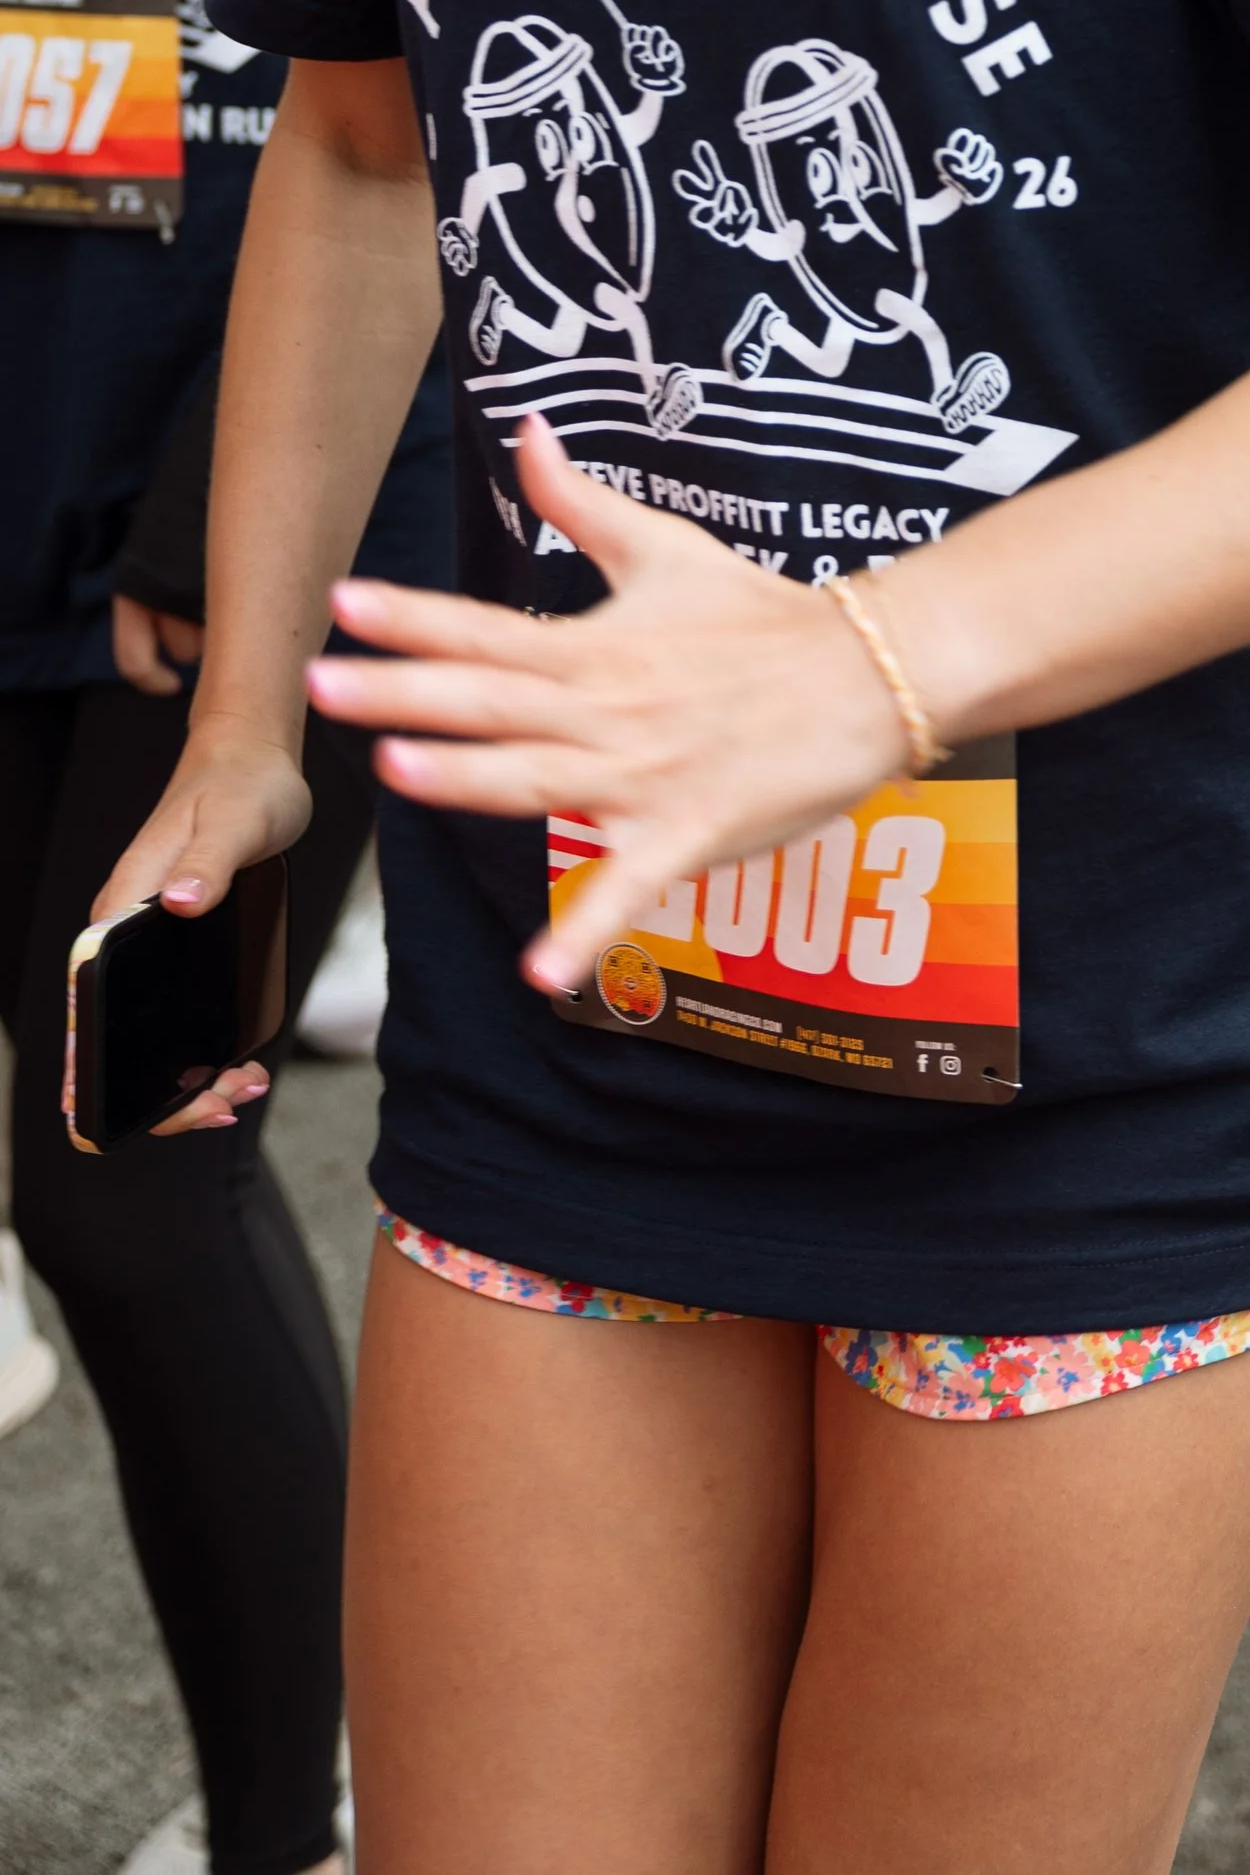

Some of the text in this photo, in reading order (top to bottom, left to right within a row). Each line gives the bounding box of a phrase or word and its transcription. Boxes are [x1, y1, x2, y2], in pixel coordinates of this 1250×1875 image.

[219, 104, 277, 146] RU
[1012, 155, 1079, 210] 26
[648, 473, 790, 537] PROFFITT
[800, 501, 950, 545] LEGACY
